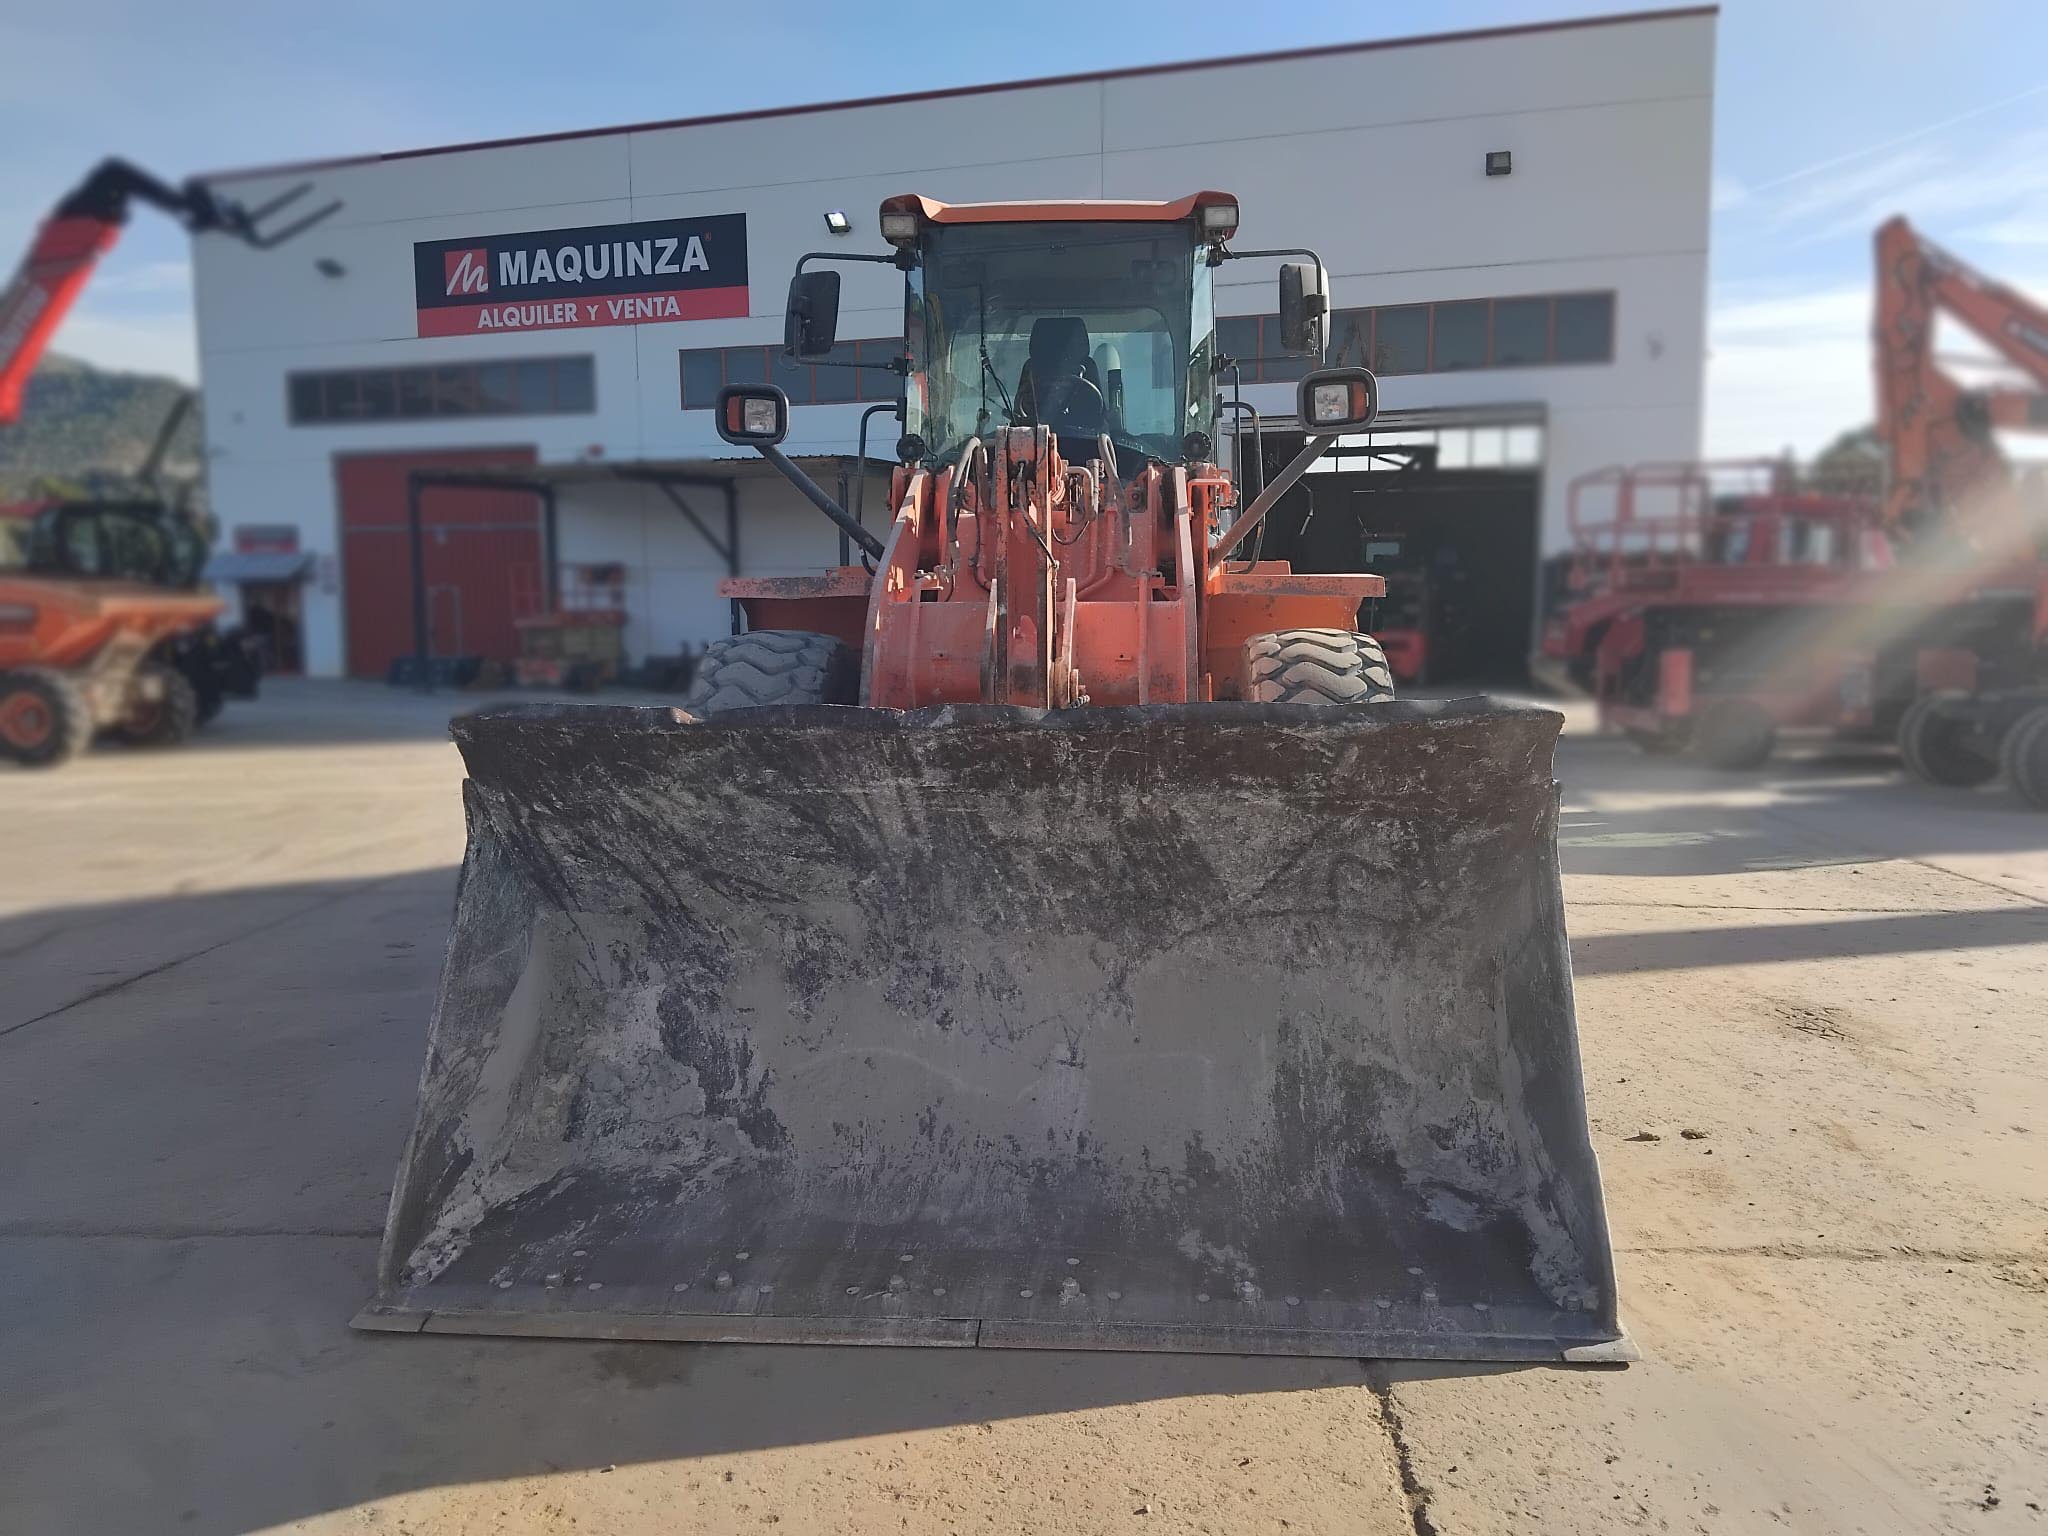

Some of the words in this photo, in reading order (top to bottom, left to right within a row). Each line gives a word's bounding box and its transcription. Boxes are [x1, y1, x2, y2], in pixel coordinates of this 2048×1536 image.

[499, 236, 710, 286] MAQUINZA
[478, 303, 578, 328] ALQUILER
[586, 305, 600, 321] Y
[607, 296, 681, 319] VENTA
